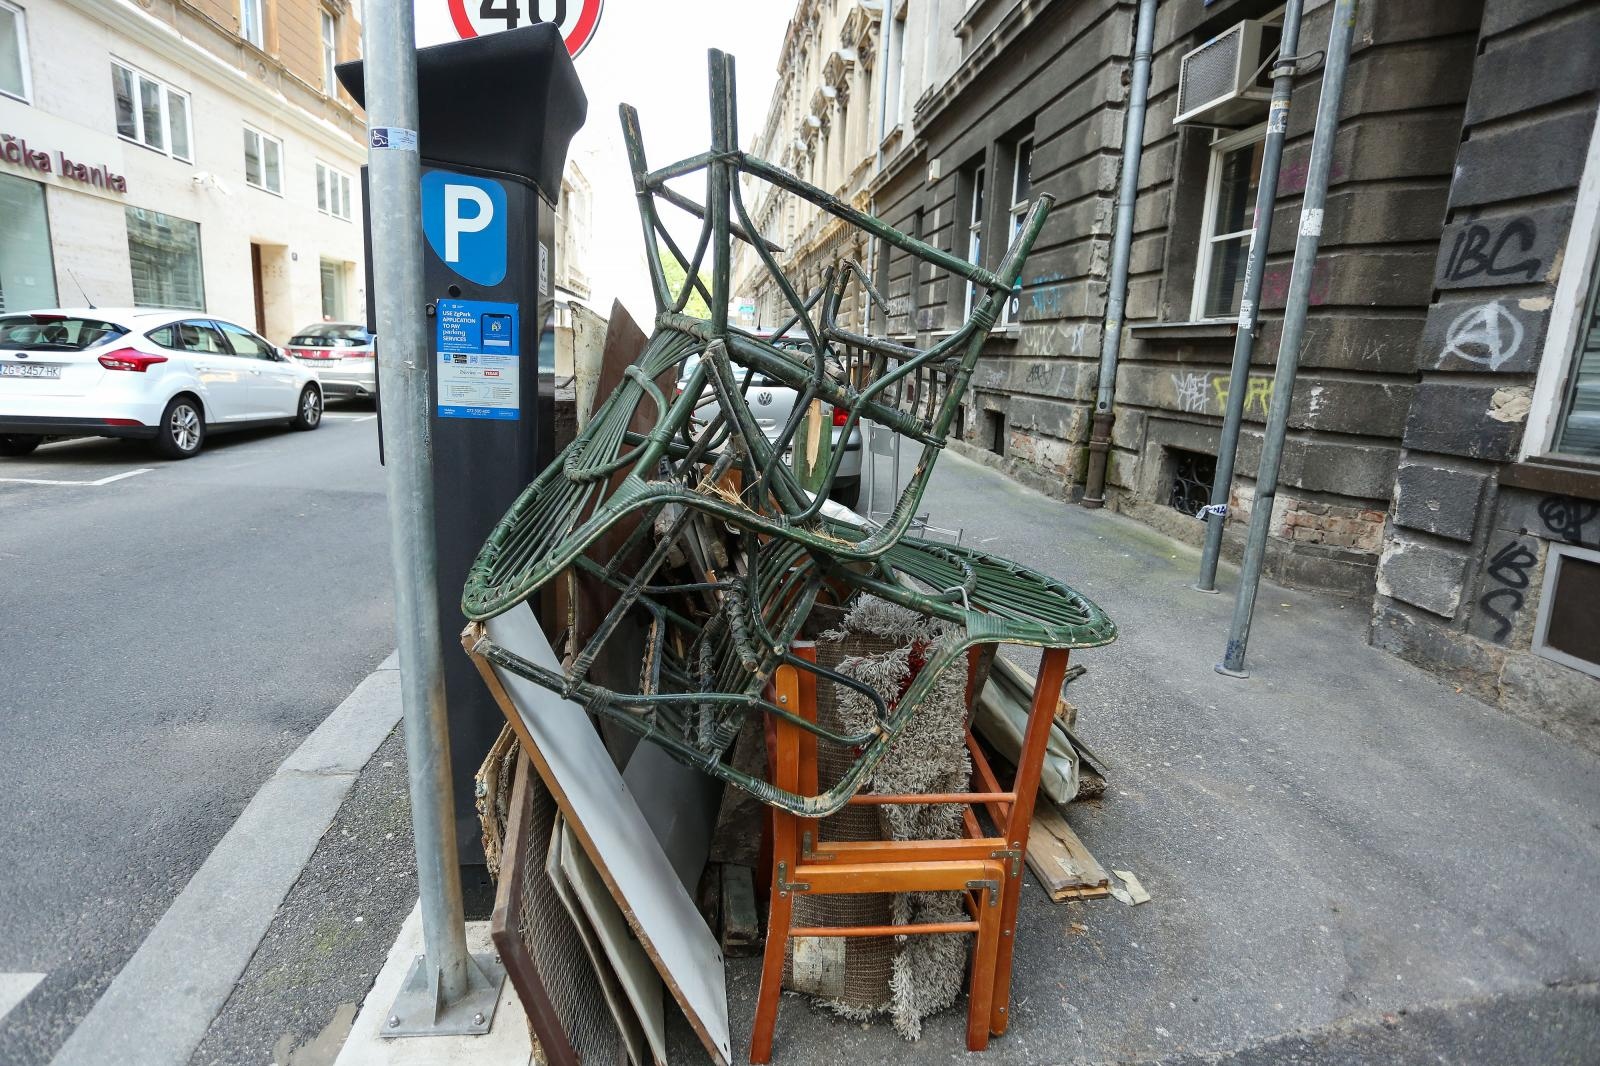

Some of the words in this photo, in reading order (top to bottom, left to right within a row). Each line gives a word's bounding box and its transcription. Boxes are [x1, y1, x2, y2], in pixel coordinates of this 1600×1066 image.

[0, 133, 52, 173] čka
[58, 150, 128, 194] banka
[444, 184, 494, 262] P
[3, 365, 15, 375] ZG
